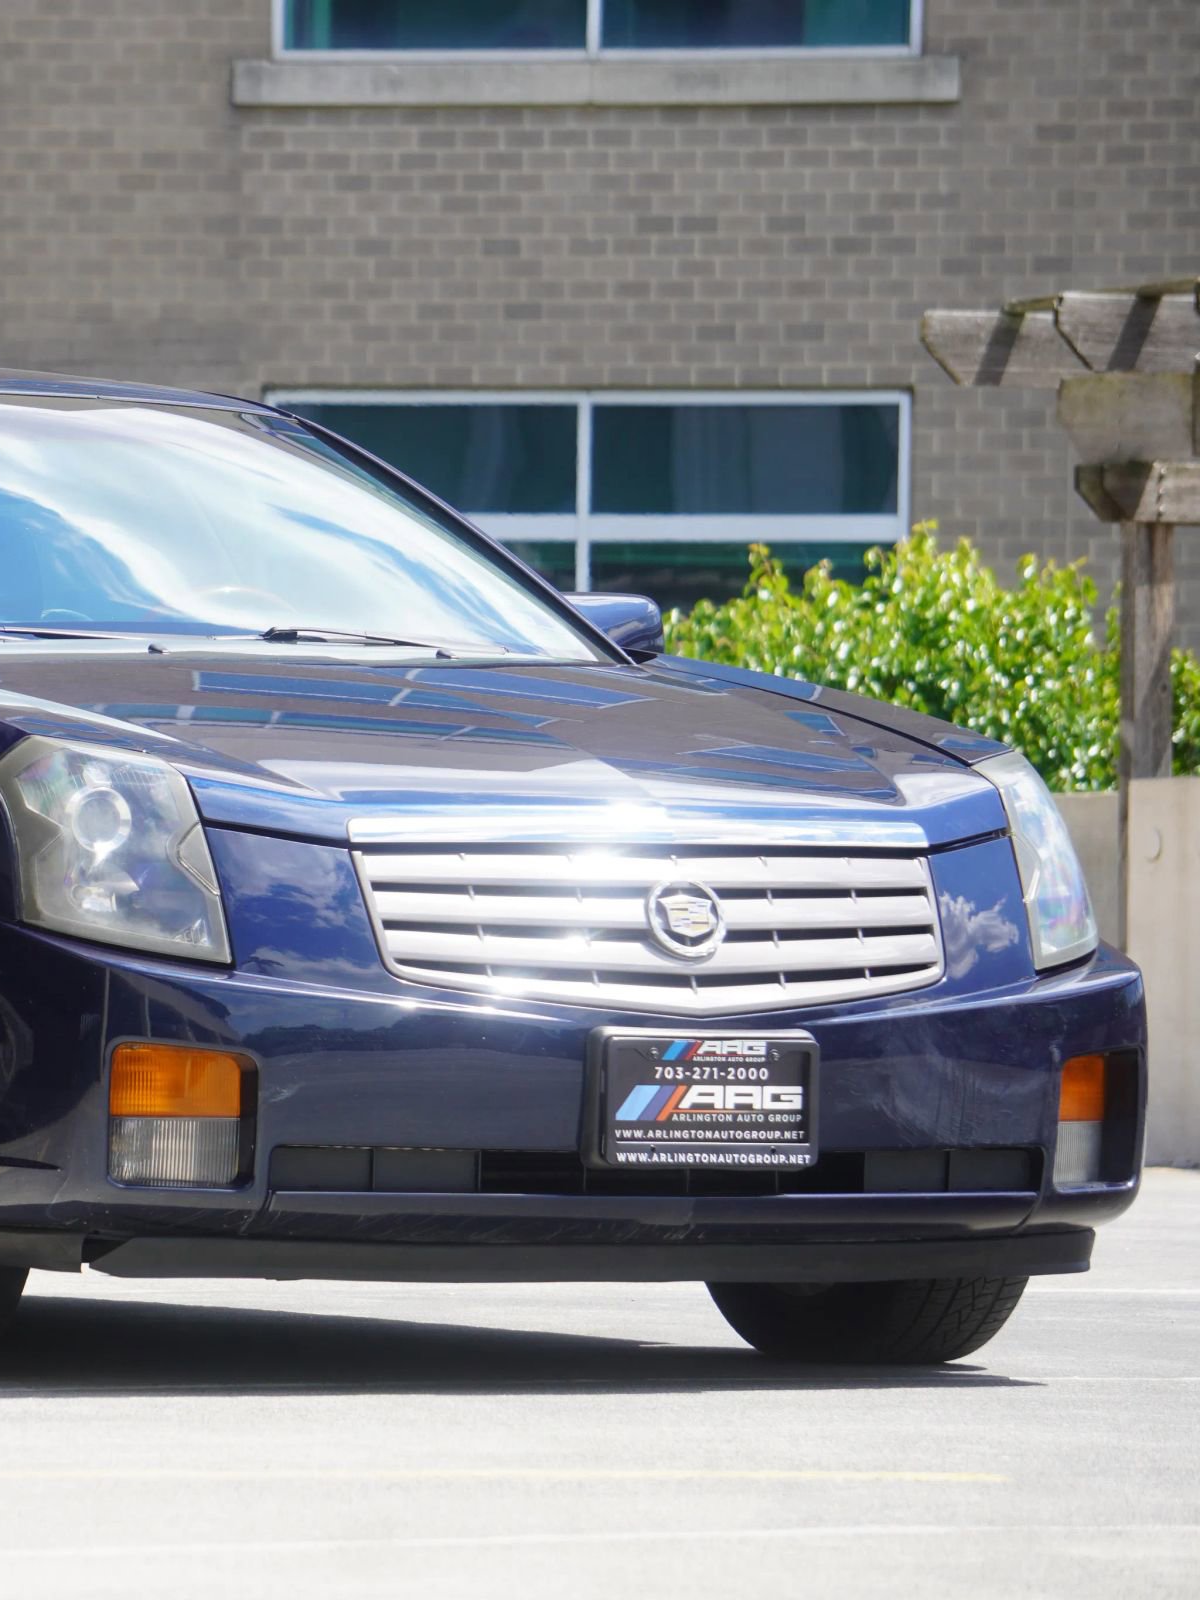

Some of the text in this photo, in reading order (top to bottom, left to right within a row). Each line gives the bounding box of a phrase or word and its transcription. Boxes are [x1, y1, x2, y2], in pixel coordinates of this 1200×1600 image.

[696, 1040, 767, 1055] AAG
[654, 1066, 769, 1080] 703-271-2000
[678, 1085, 803, 1110] AAG
[671, 1113, 802, 1122] ARLINGTON AUTO GROUP
[616, 1152, 811, 1164] WWW.ARLINGTONAUTOGROUP.NET
